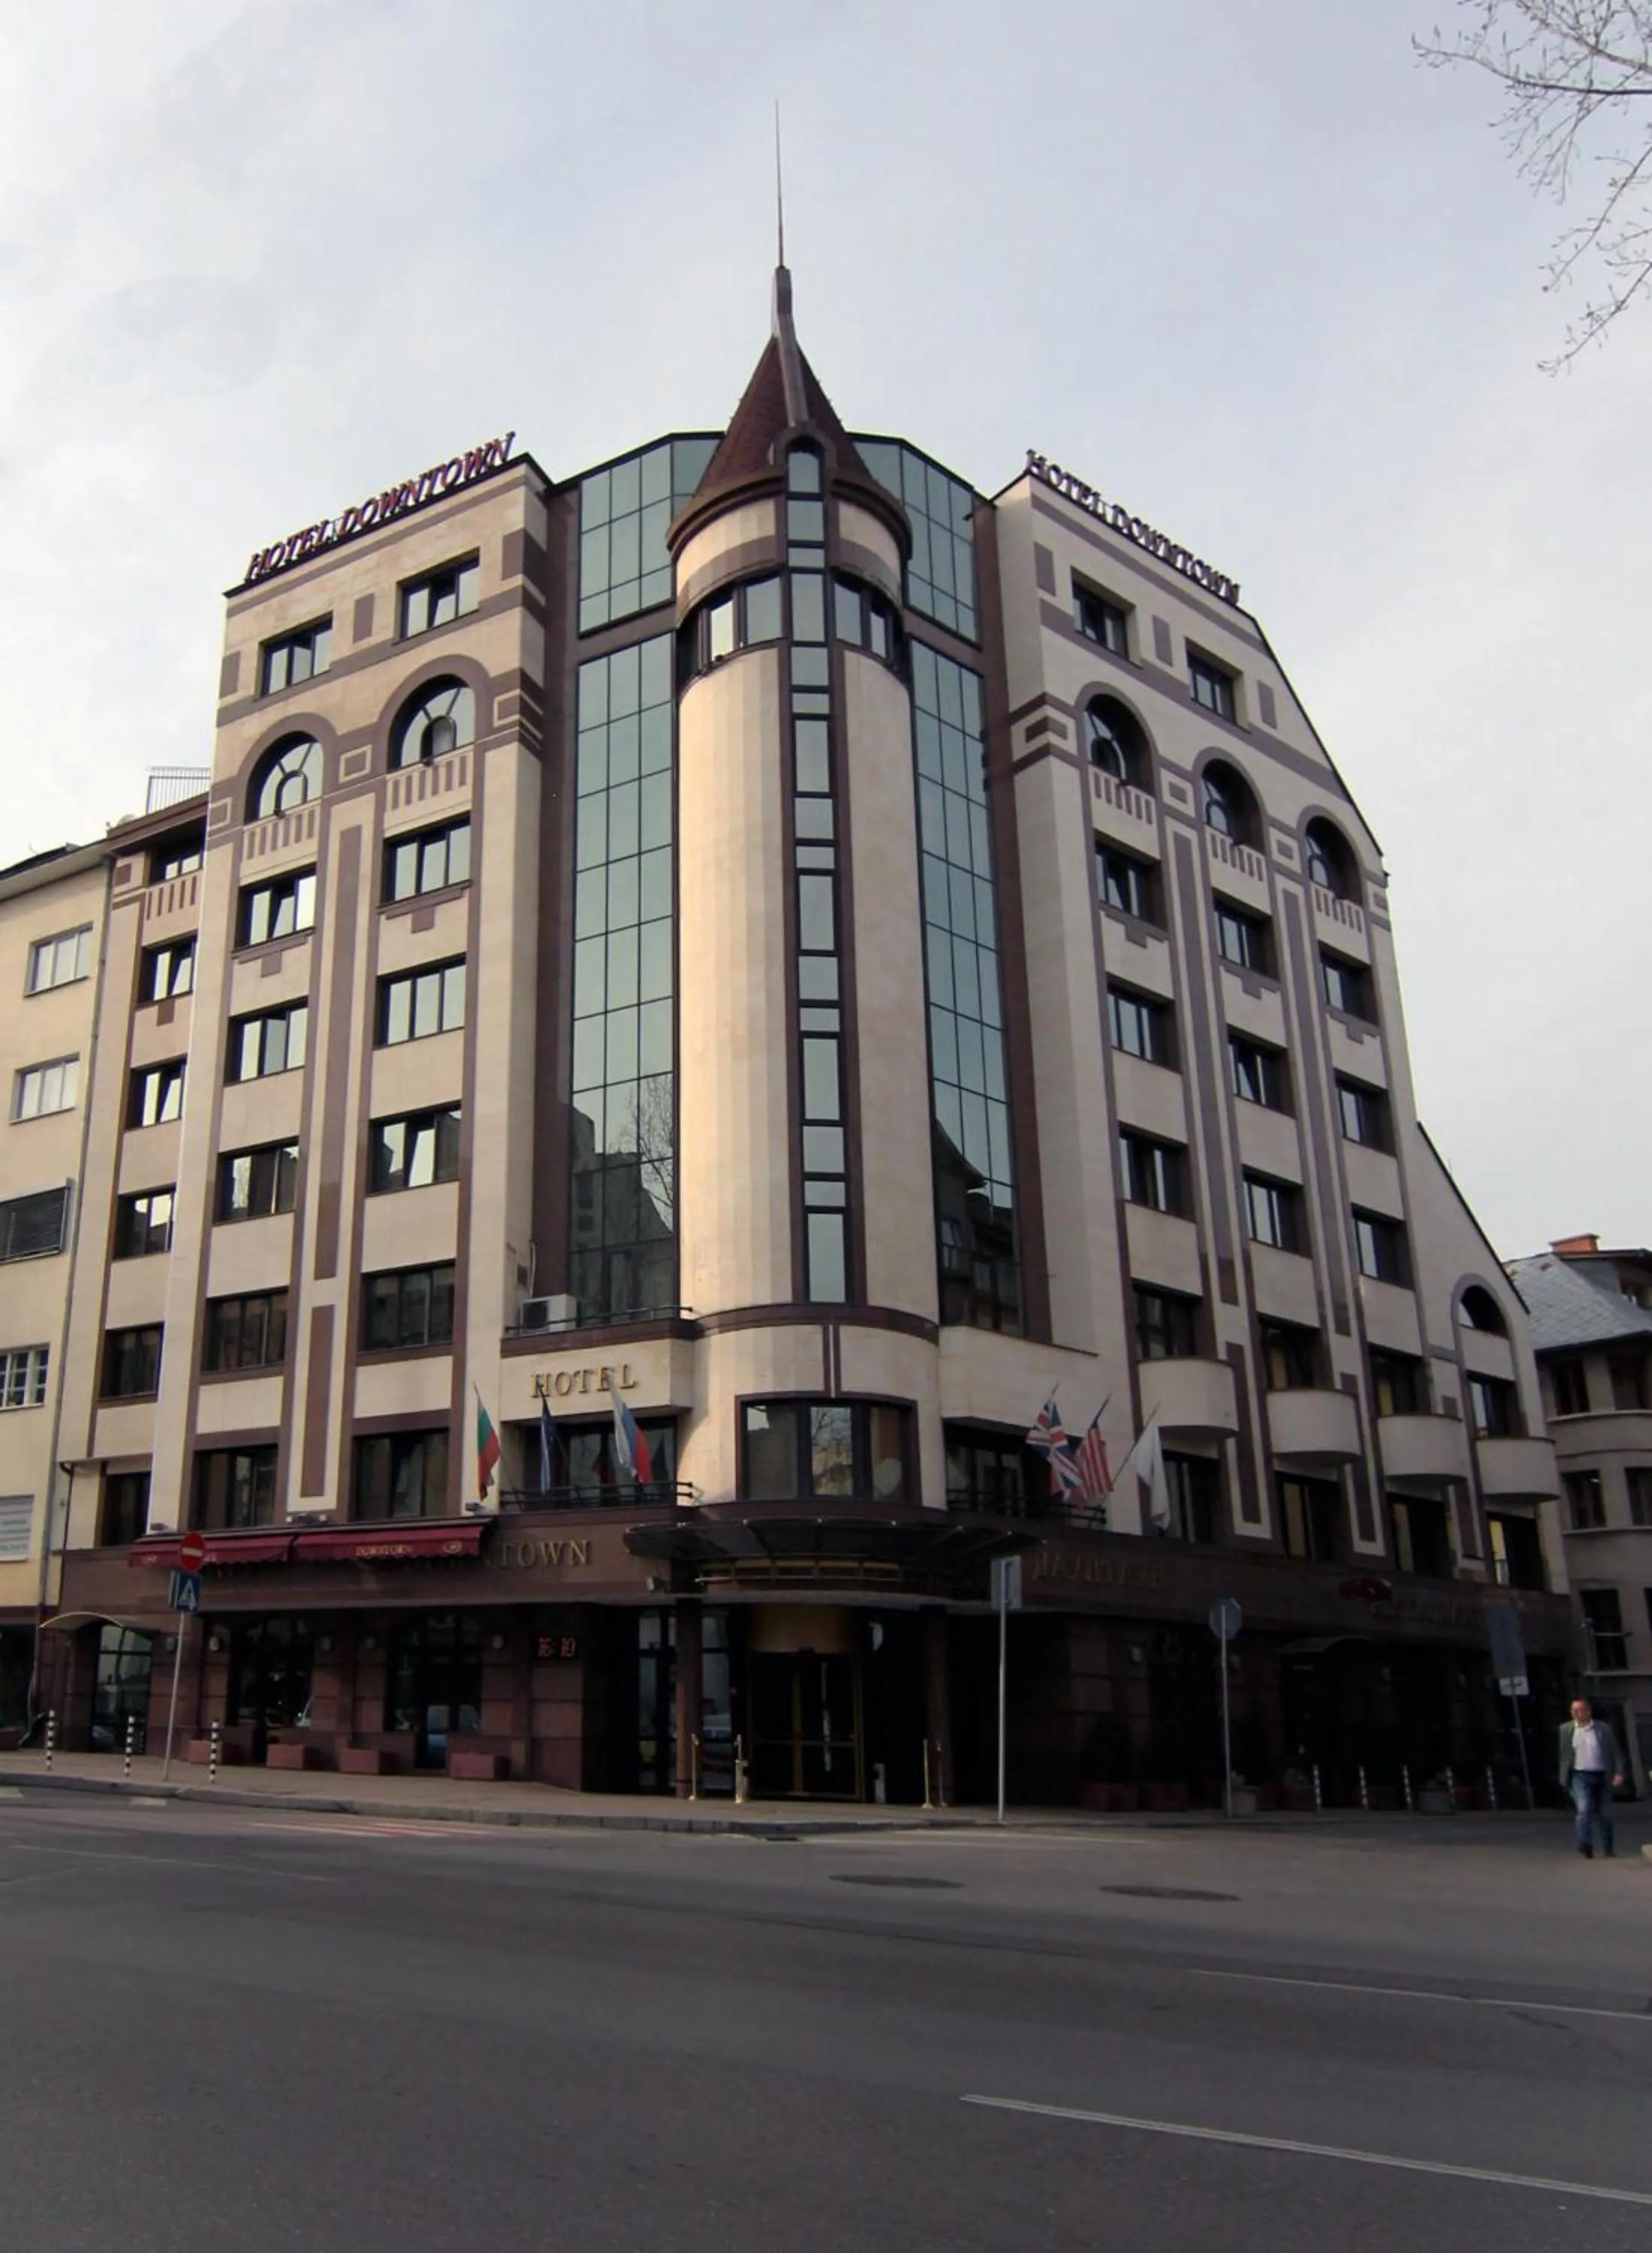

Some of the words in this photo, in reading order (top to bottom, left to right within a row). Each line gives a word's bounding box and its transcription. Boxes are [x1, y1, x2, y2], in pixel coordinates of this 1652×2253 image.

[245, 520, 330, 581] HOTEL
[336, 430, 516, 538] DOWNTOWN
[1026, 448, 1102, 515] HOTEL
[1112, 504, 1241, 605] DOWNTOWN
[529, 1362, 638, 1398] HOTEL
[482, 1539, 591, 1570] TOWN
